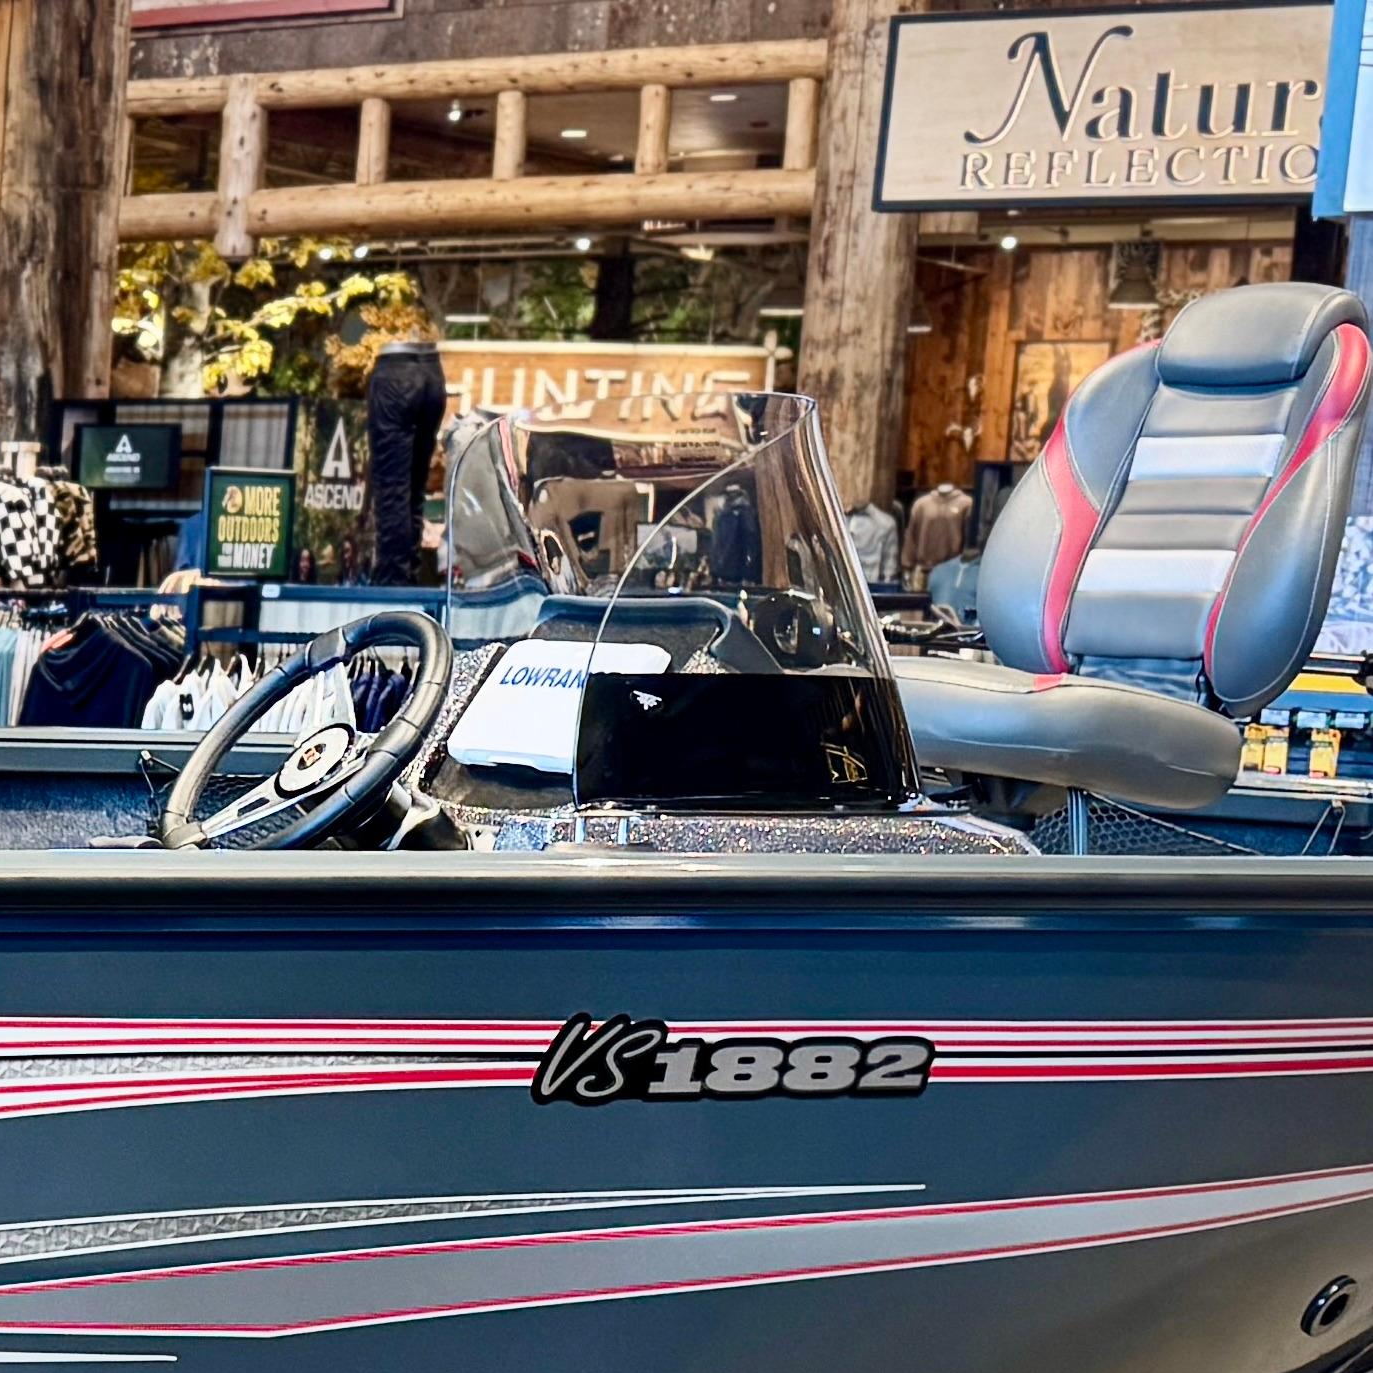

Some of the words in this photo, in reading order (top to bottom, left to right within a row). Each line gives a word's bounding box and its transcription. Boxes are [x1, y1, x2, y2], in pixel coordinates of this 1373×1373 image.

[963, 24, 1322, 147] Natur
[244, 485, 281, 517] MORE
[304, 482, 366, 511] ASCEND
[217, 515, 280, 543] OUTDOORS
[232, 542, 277, 570] MONEY
